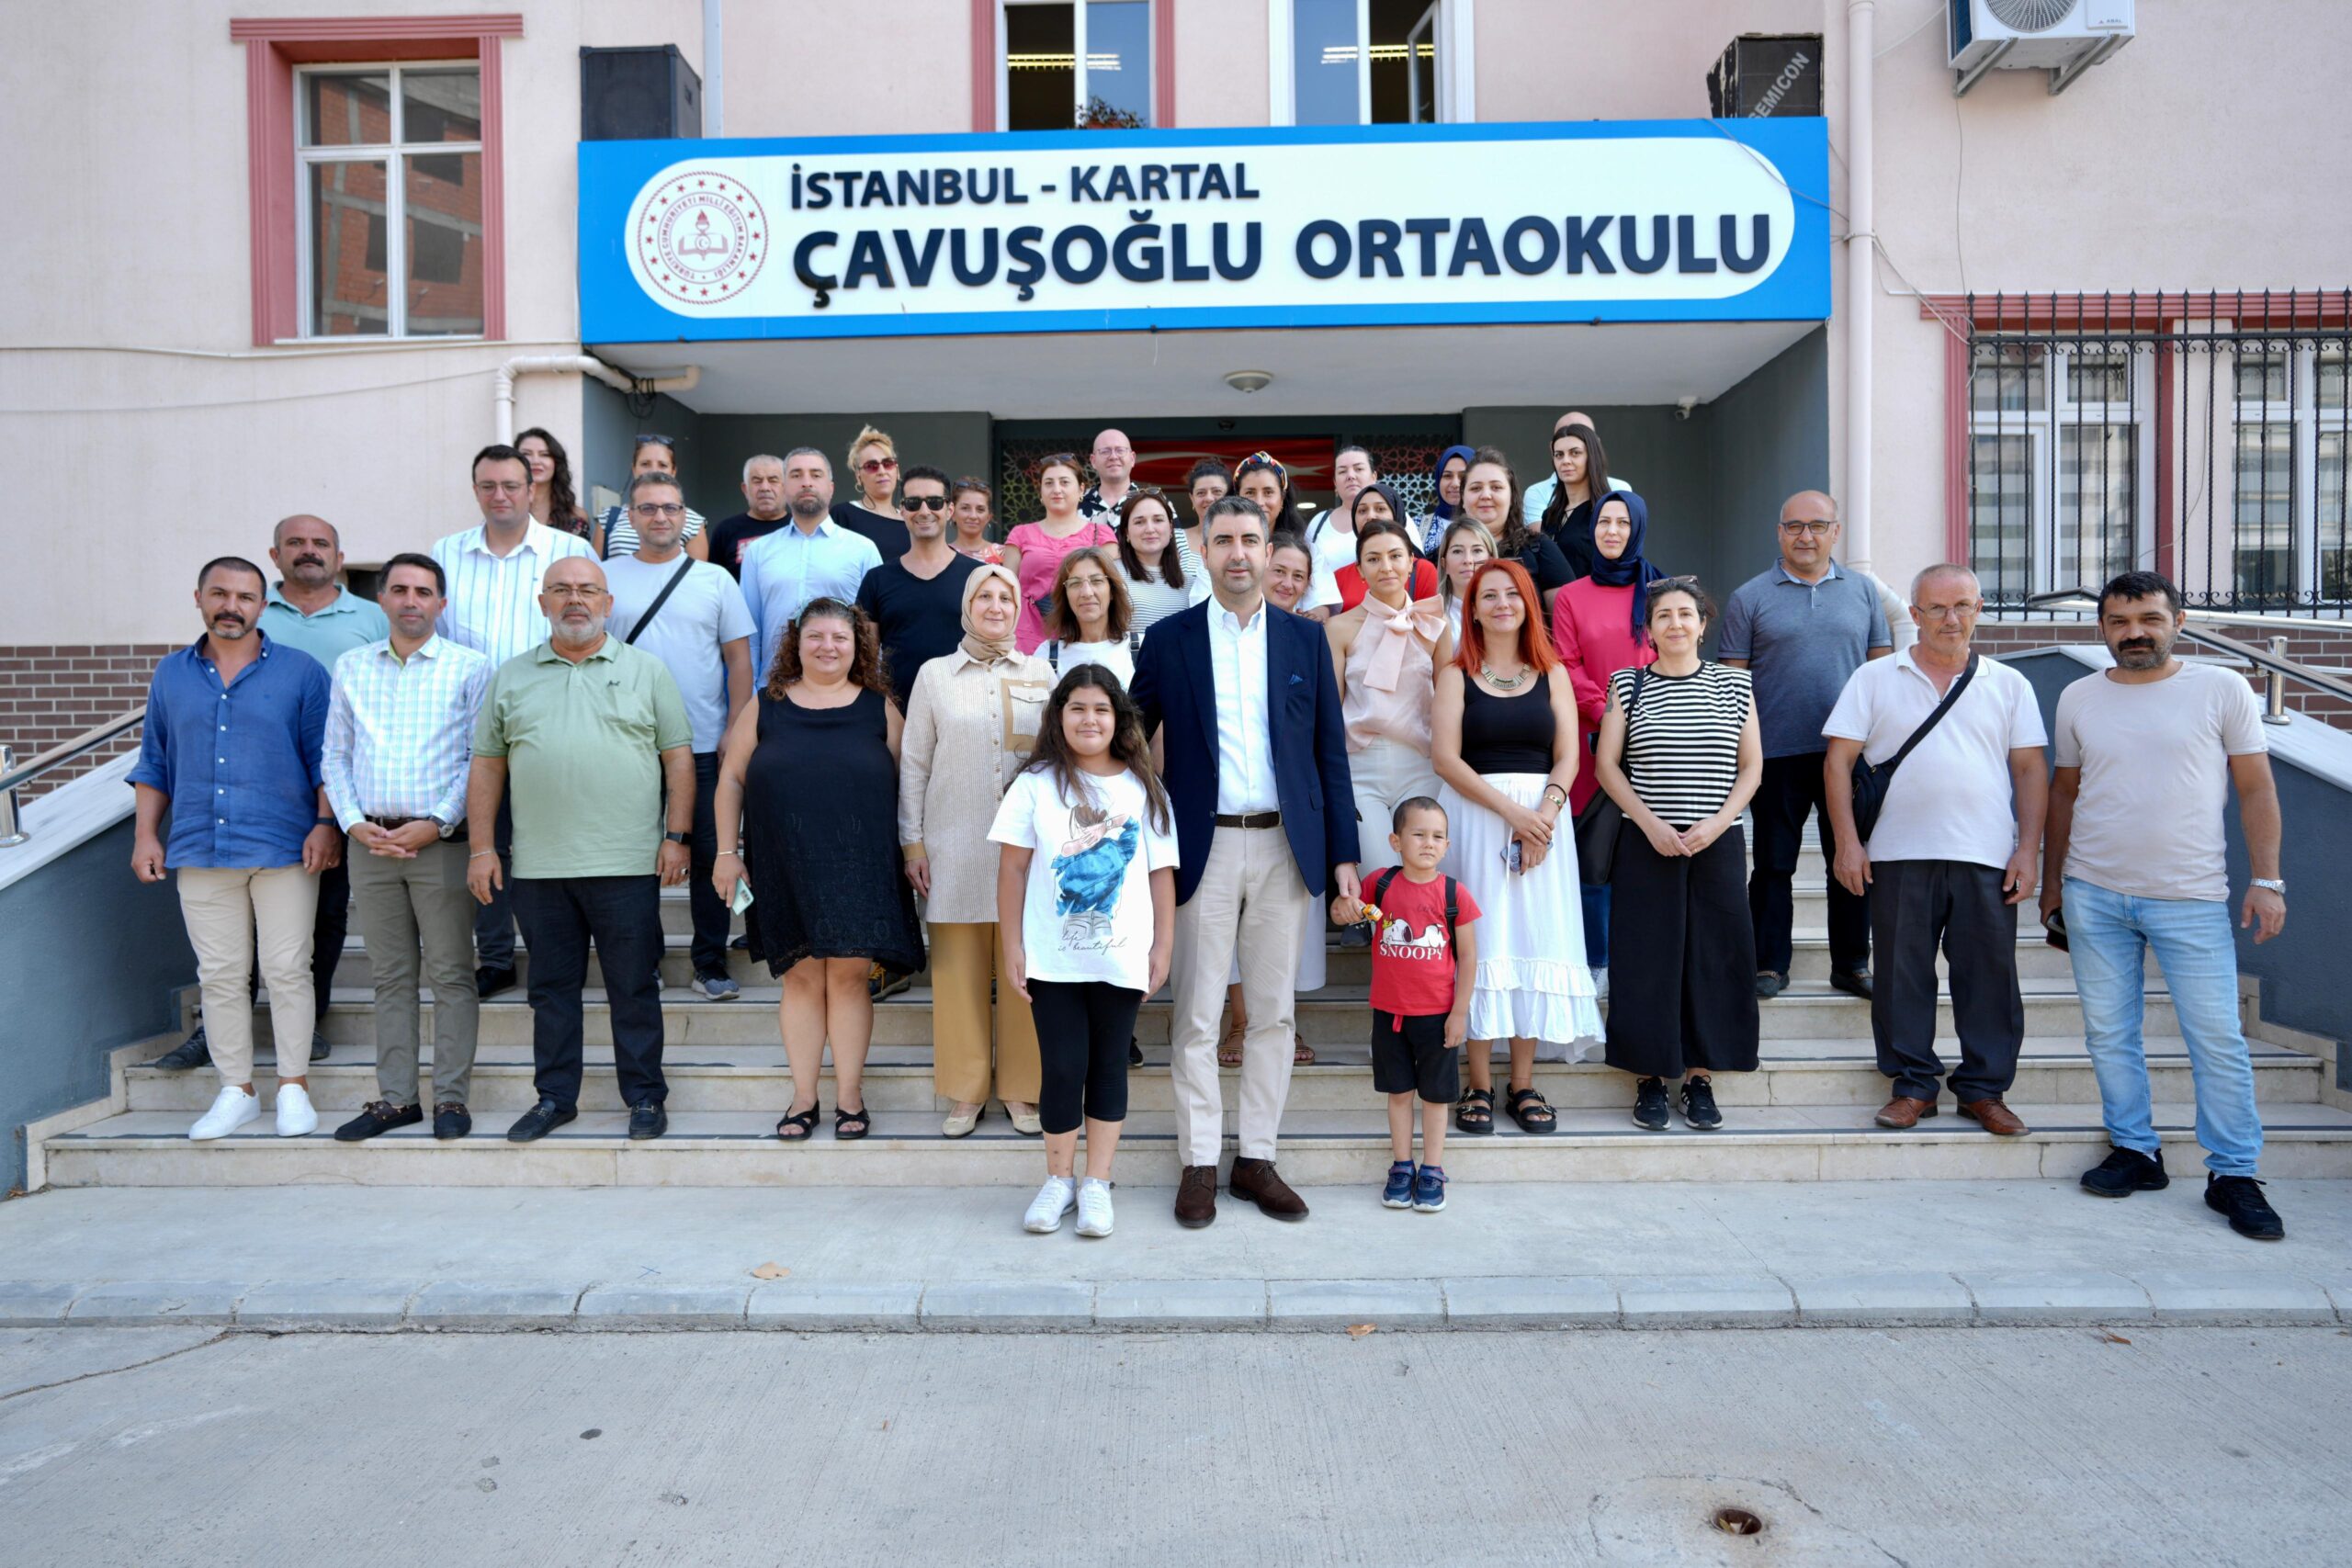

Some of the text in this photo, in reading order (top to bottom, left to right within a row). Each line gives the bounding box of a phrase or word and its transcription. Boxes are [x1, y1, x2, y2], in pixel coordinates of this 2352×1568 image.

[792, 163, 1028, 210] İSTANBUL
[1071, 163, 1260, 202] KARTAL
[793, 209, 1770, 310] ÇAVUŞOĞLU ORTAOKULU
[1072, 936, 1127, 956] beautiful
[1379, 943, 1443, 961] SNOOPY
